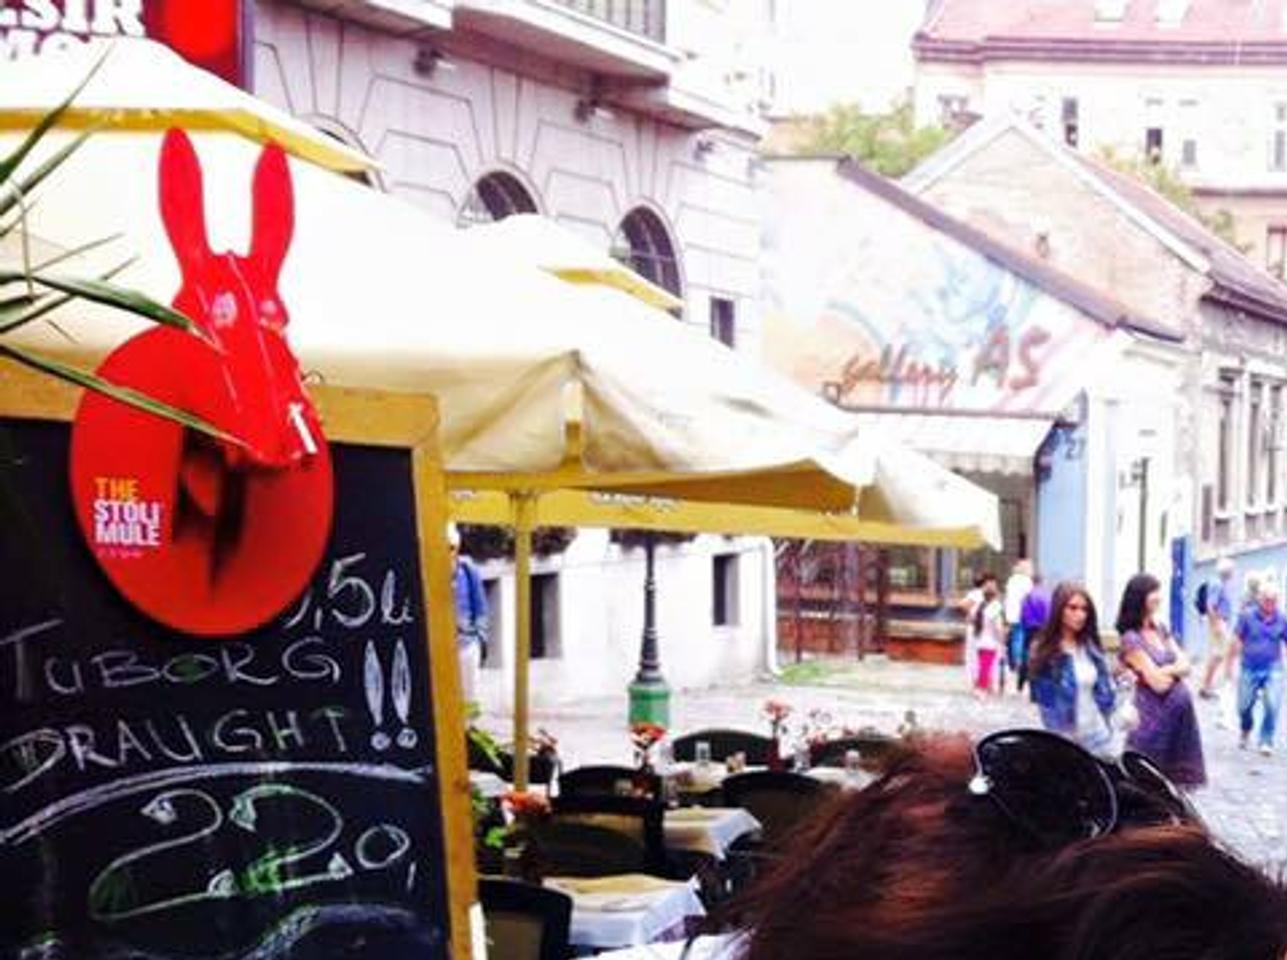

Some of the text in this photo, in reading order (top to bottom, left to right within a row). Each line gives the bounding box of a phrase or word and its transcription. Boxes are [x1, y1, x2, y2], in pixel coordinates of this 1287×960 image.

[94, 476, 139, 500] THE
[93, 499, 161, 523] STOLI
[95, 520, 161, 546] MULE
